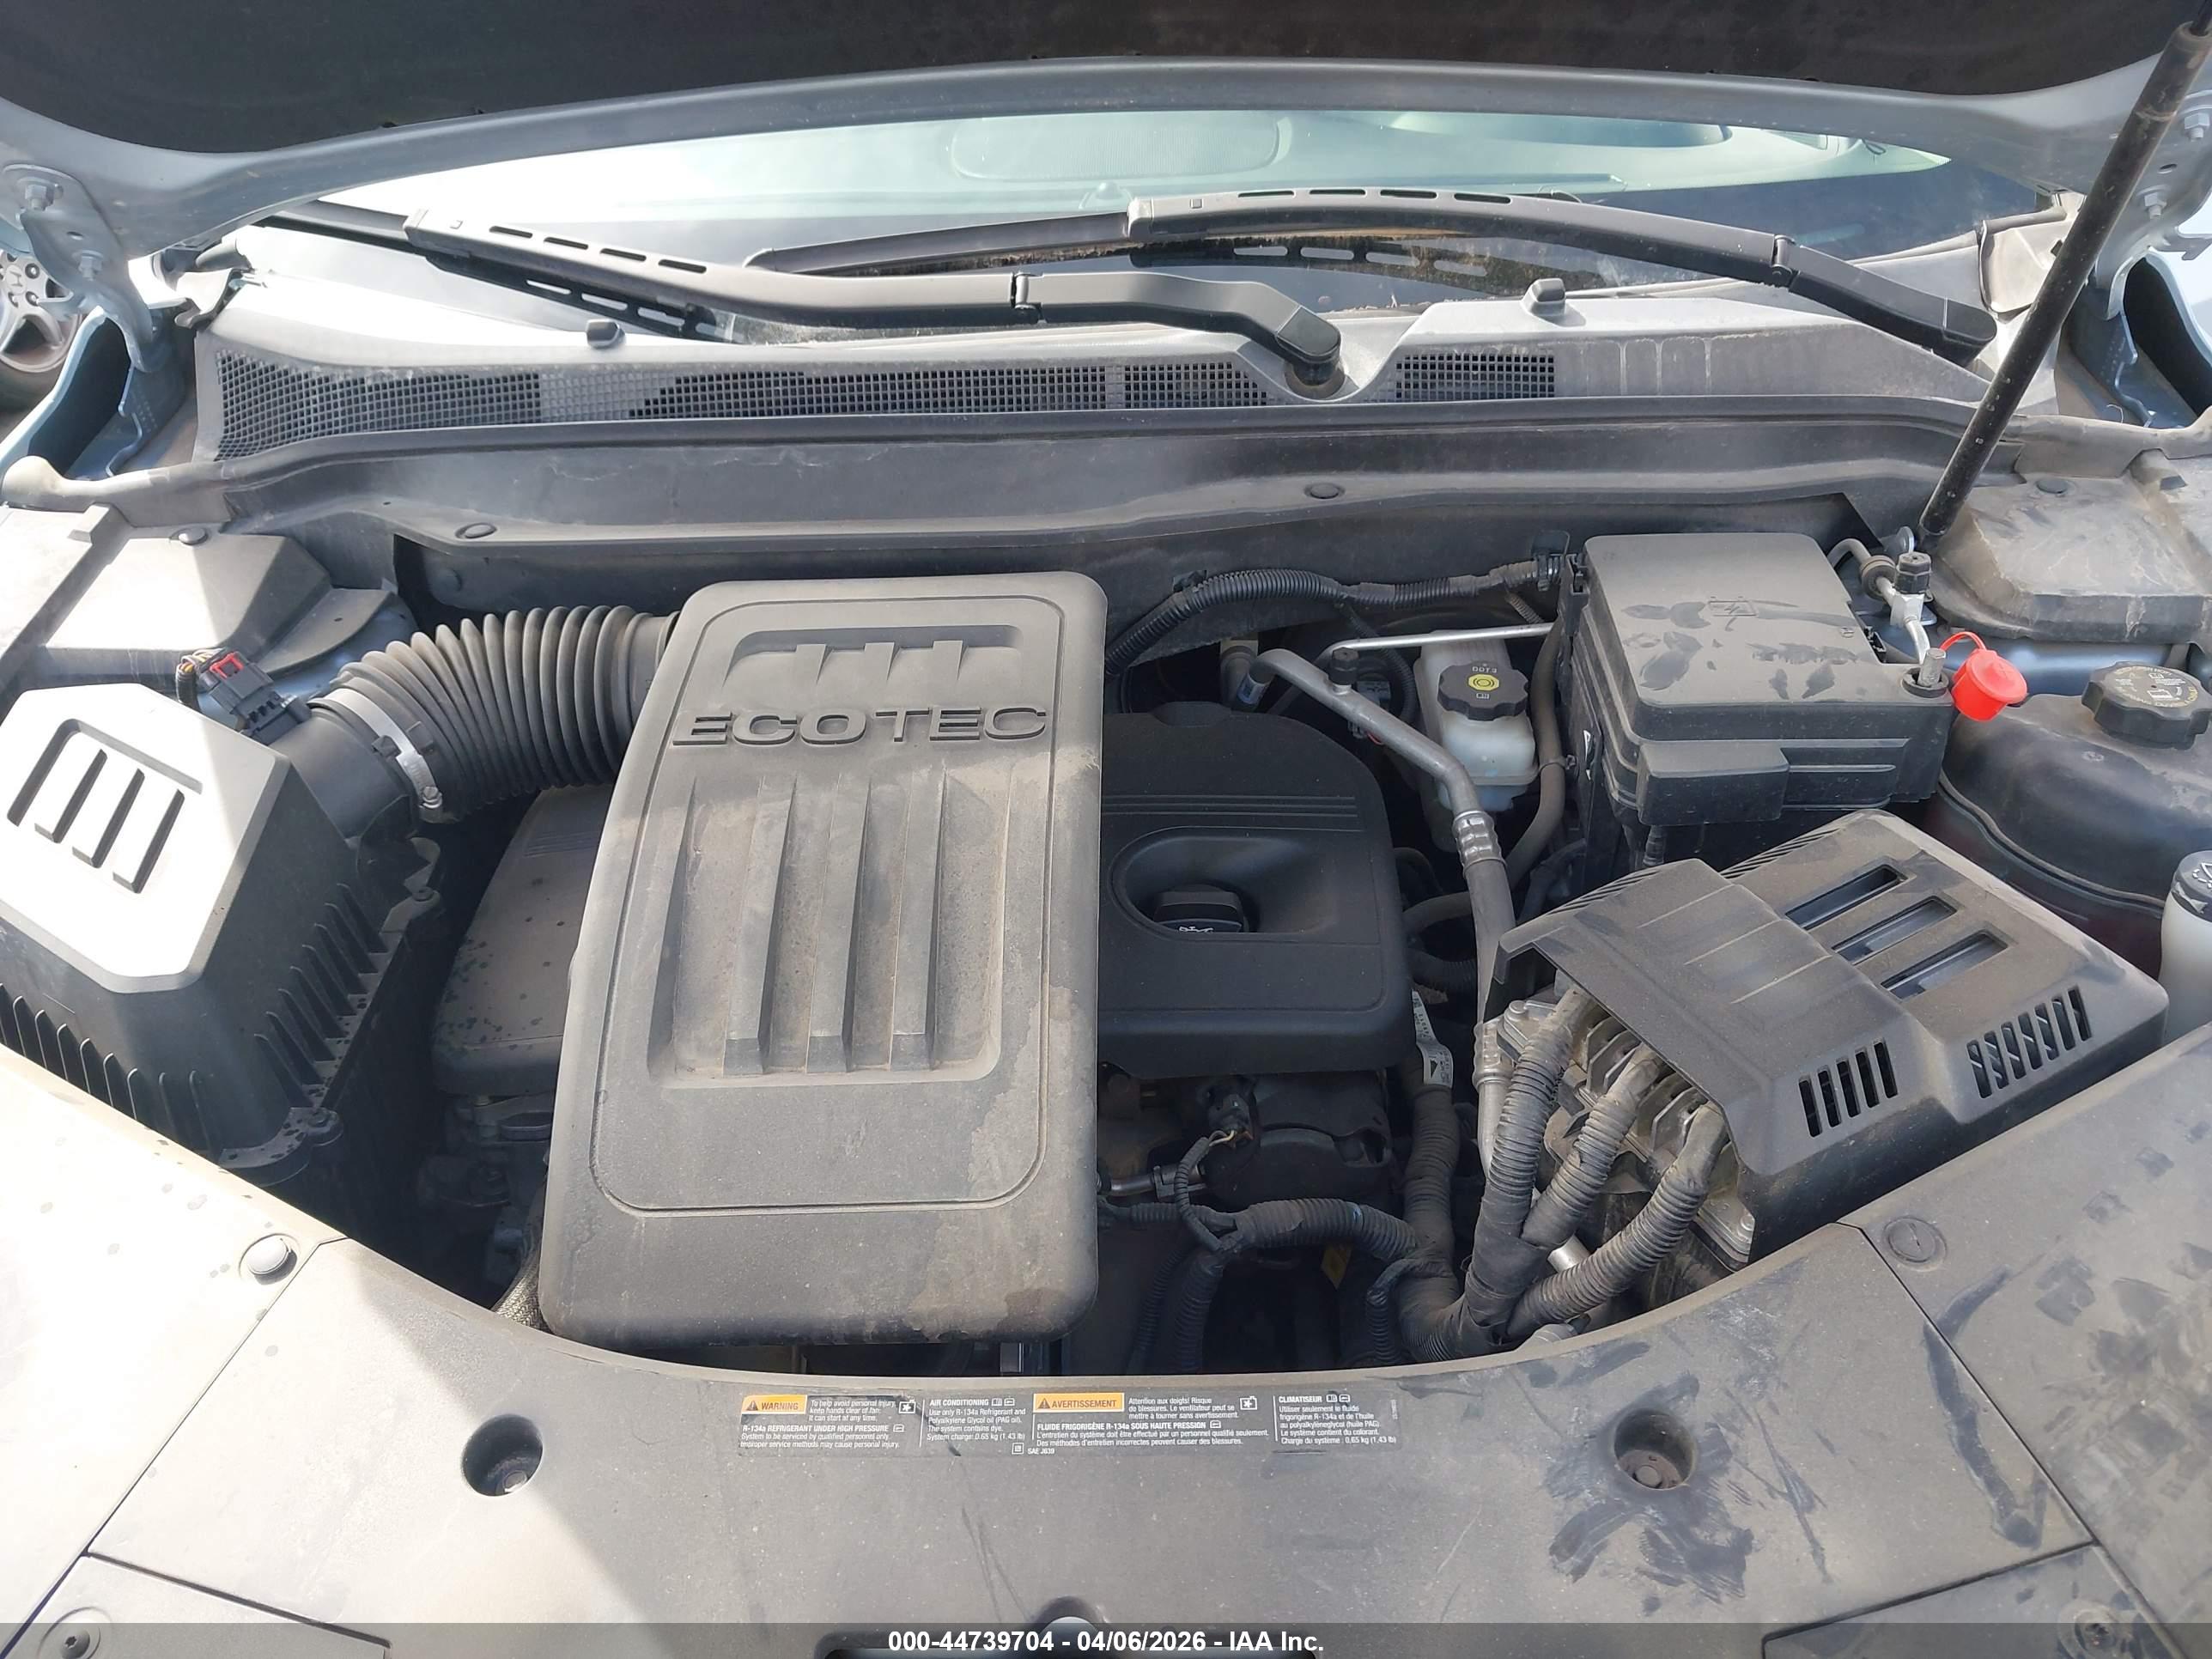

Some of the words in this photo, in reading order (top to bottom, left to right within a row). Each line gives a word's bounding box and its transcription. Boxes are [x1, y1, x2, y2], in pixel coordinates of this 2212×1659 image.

[672, 707, 1047, 746] ECOTEC
[761, 1402, 799, 1411] WARNING
[1051, 1400, 1117, 1408] AVERTISSEMENT
[1061, 1421, 1105, 1431] FRIGORIGÈNE
[845, 1432, 875, 1441] personnel
[1079, 1431, 1105, 1439] système
[1180, 1430, 1211, 1438] personnel
[1212, 1429, 1235, 1437] qualifié
[1289, 1429, 1316, 1437] système
[1151, 1438, 1176, 1447] peuvent
[1280, 1437, 1304, 1446] Charge
[1314, 1437, 1340, 1445] système
[1360, 1436, 1370, 1444] kg
